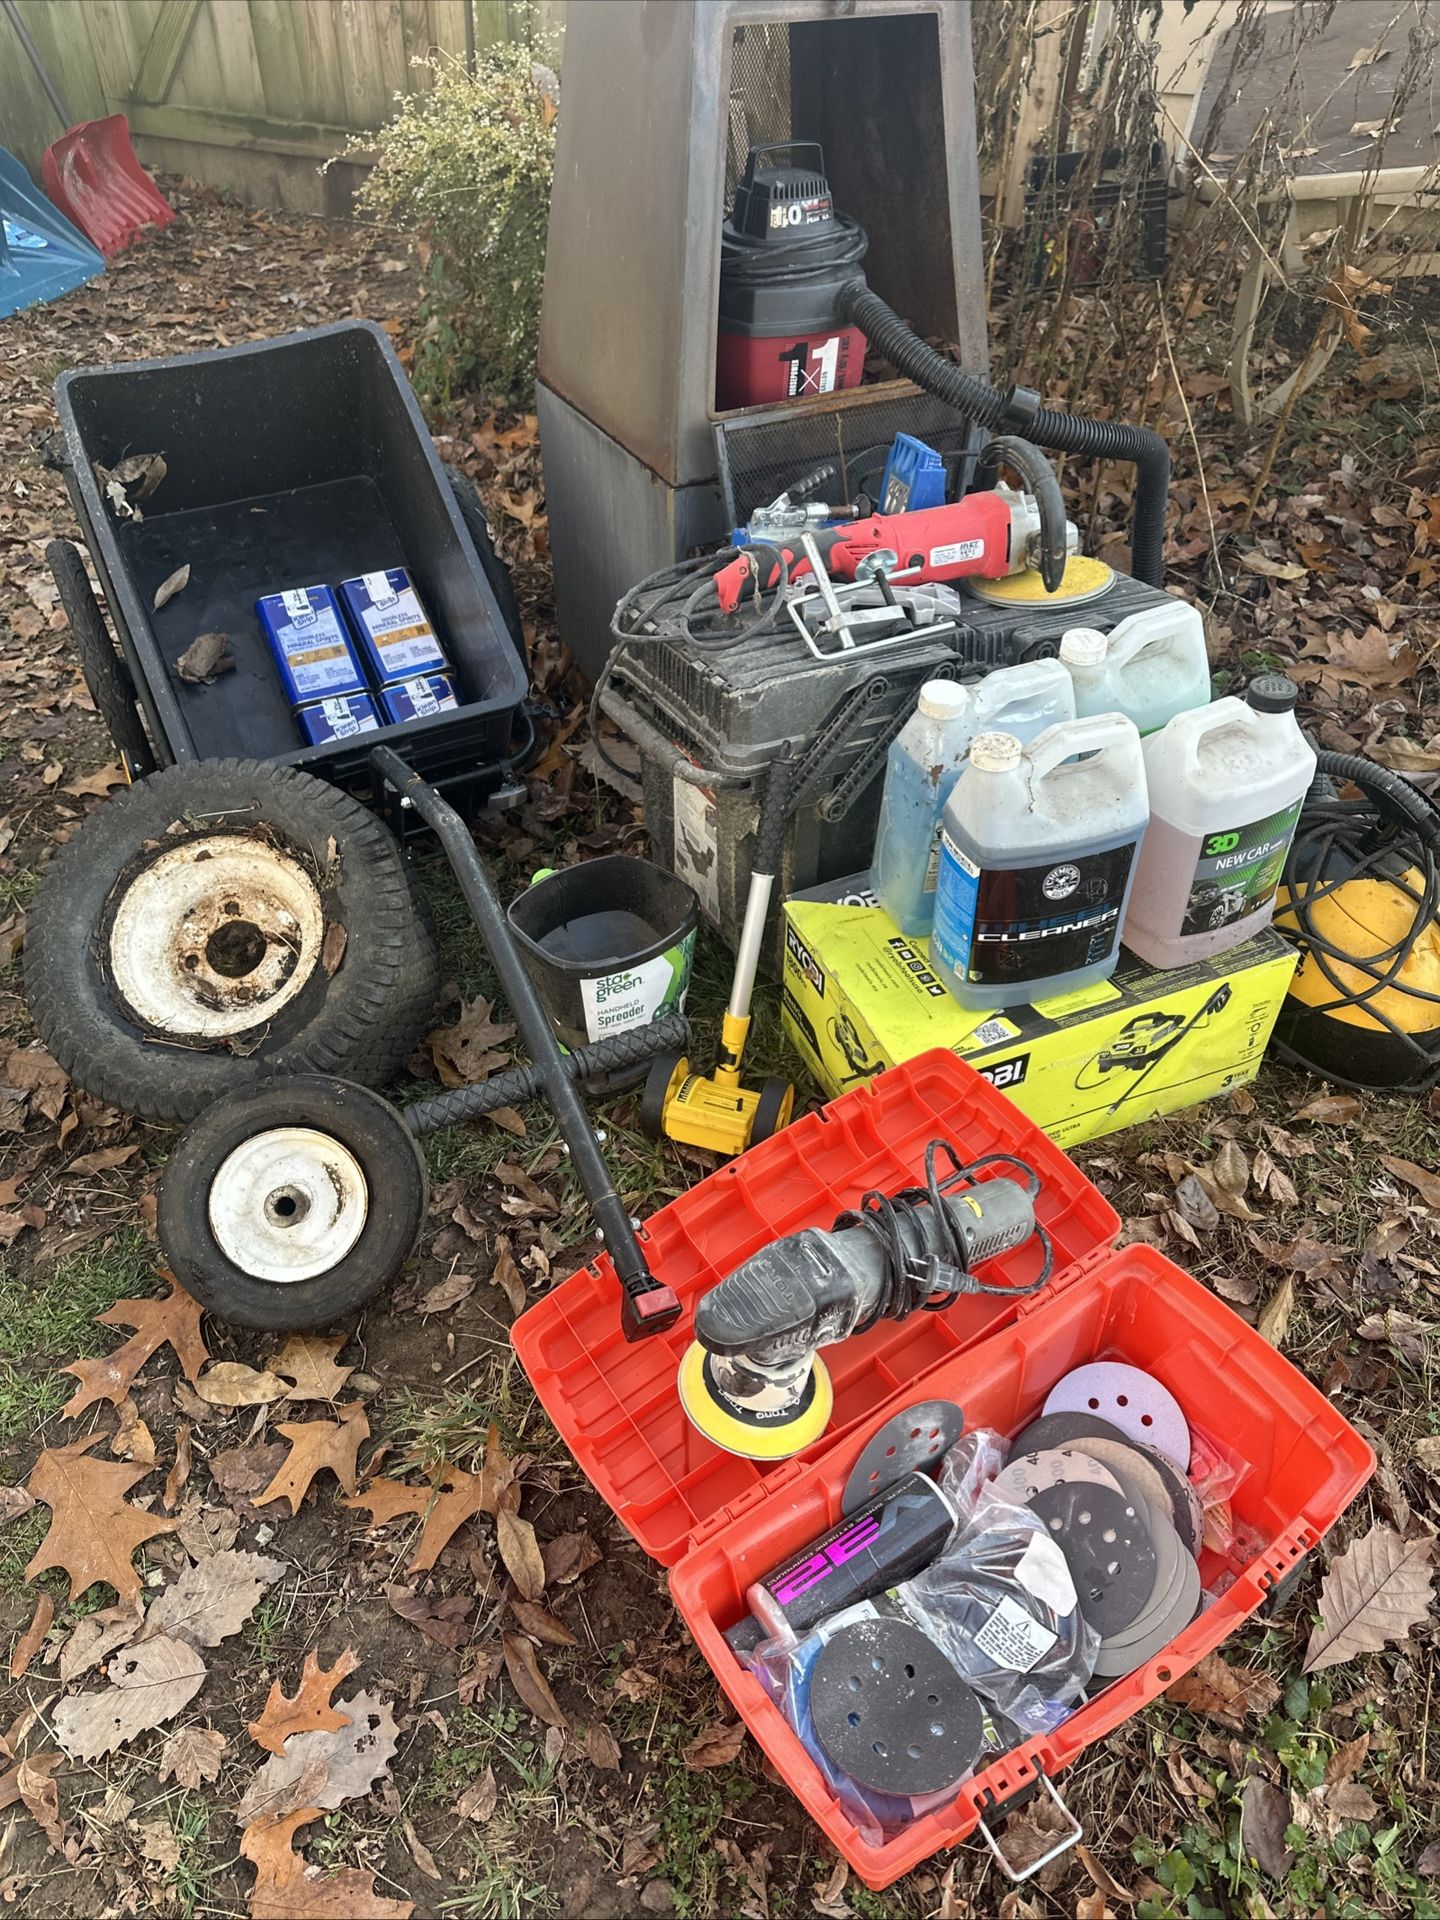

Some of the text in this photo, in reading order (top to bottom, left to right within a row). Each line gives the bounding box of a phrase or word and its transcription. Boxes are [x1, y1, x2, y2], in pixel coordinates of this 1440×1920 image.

[789, 359, 799, 396] HORSEPOWER
[372, 613, 421, 630] MINERAL SPIRITS
[287, 633, 339, 649] MINERAL SPIRITS
[416, 699, 436, 713] Klean
[335, 720, 356, 733] Klean
[1205, 831, 1240, 856] 3D
[1215, 853, 1245, 871] NEW
[1247, 842, 1270, 861] CAR
[1046, 866, 1079, 886] CHEMICAL
[977, 907, 1119, 942] CLEANER
[979, 902, 1111, 933] WHEEL
[788, 928, 823, 993] RYOBI
[884, 947, 923, 994] @ryobitoolsusa
[596, 975, 643, 1003] green
[597, 999, 640, 1016] HANDHELD
[598, 1004, 645, 1026] Spreader
[1220, 1074, 1234, 1088] 3
[766, 1477, 919, 1587] OPTICAL GRADE EXTREME COMPOUND
